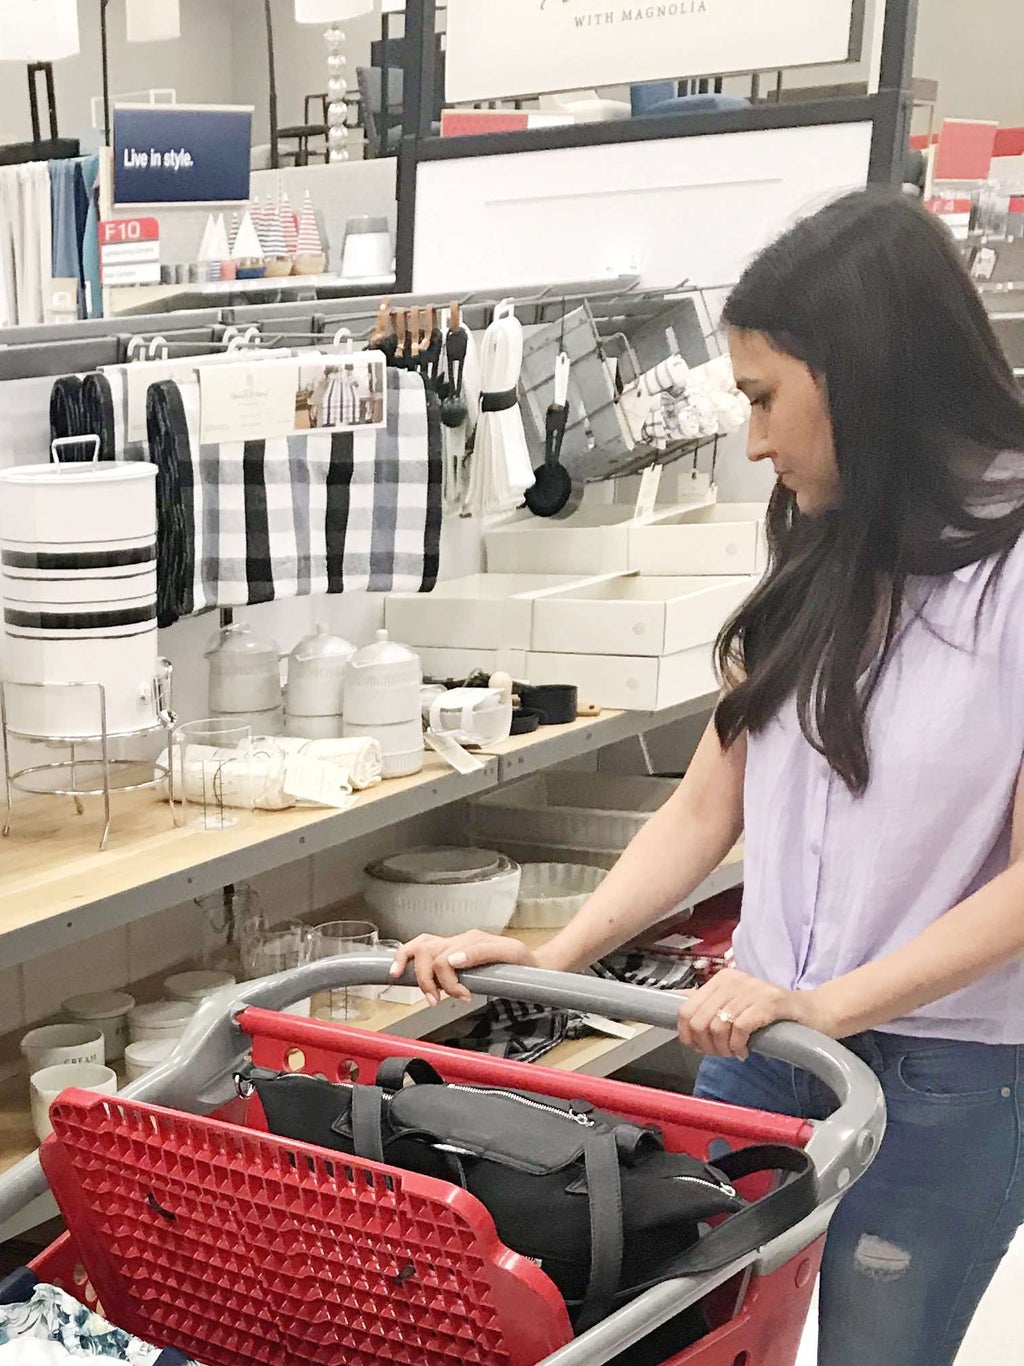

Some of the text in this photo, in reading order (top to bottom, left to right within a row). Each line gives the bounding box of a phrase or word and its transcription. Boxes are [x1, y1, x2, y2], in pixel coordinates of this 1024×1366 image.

[574, 1, 707, 28] WITH MAGNOLIA
[124, 147, 194, 171] Live in style.
[104, 221, 141, 241] F10
